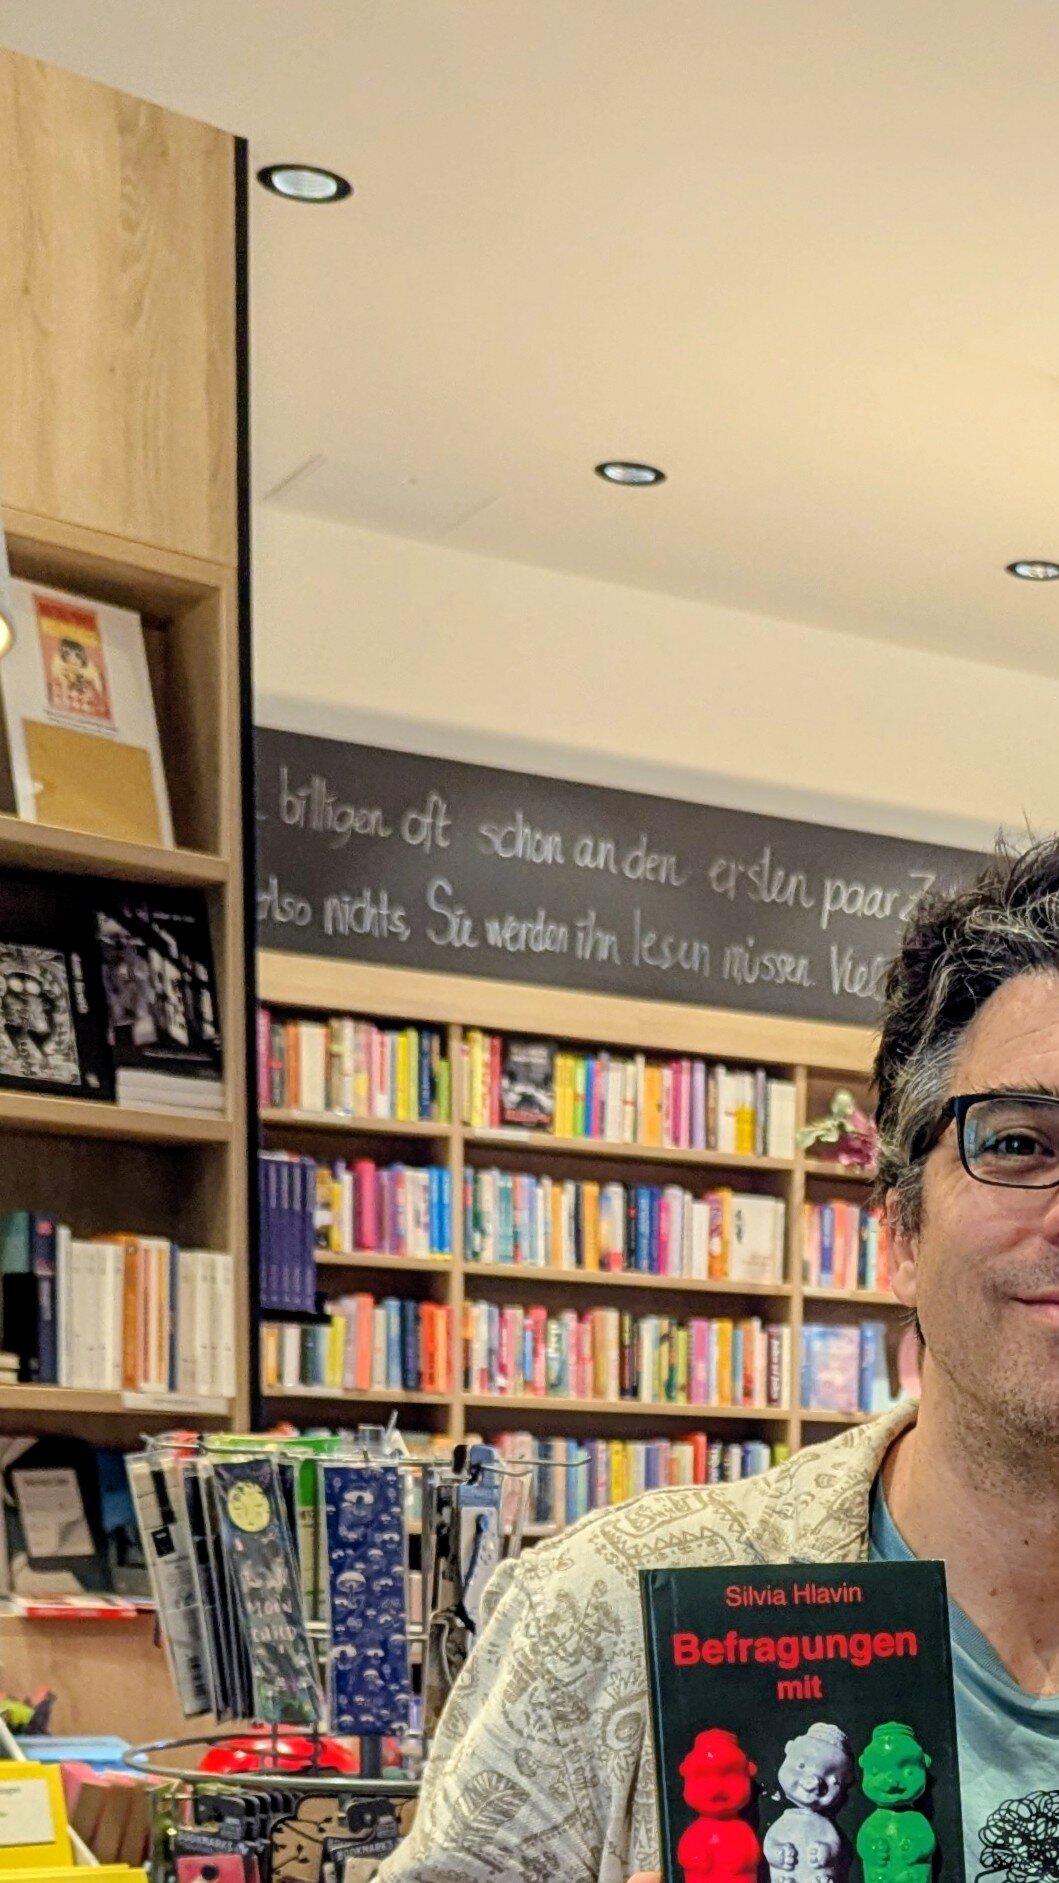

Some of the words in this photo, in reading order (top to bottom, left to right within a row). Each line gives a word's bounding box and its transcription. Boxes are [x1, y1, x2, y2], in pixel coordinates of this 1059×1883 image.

[279, 765, 393, 850] billigen
[403, 790, 451, 854] oft
[478, 808, 565, 865] schon
[573, 834, 617, 875] an
[622, 831, 691, 887] den
[708, 845, 815, 909] ersten
[820, 877, 899, 930] paar
[426, 874, 480, 949] Sie
[483, 906, 569, 953] werden
[575, 907, 622, 966] ihn
[631, 905, 710, 978] lesen
[724, 1585, 787, 1609] Silvia
[793, 1584, 863, 1606] Hlavin
[672, 1628, 919, 1671] Befragungen
[776, 1675, 822, 1701] mit
